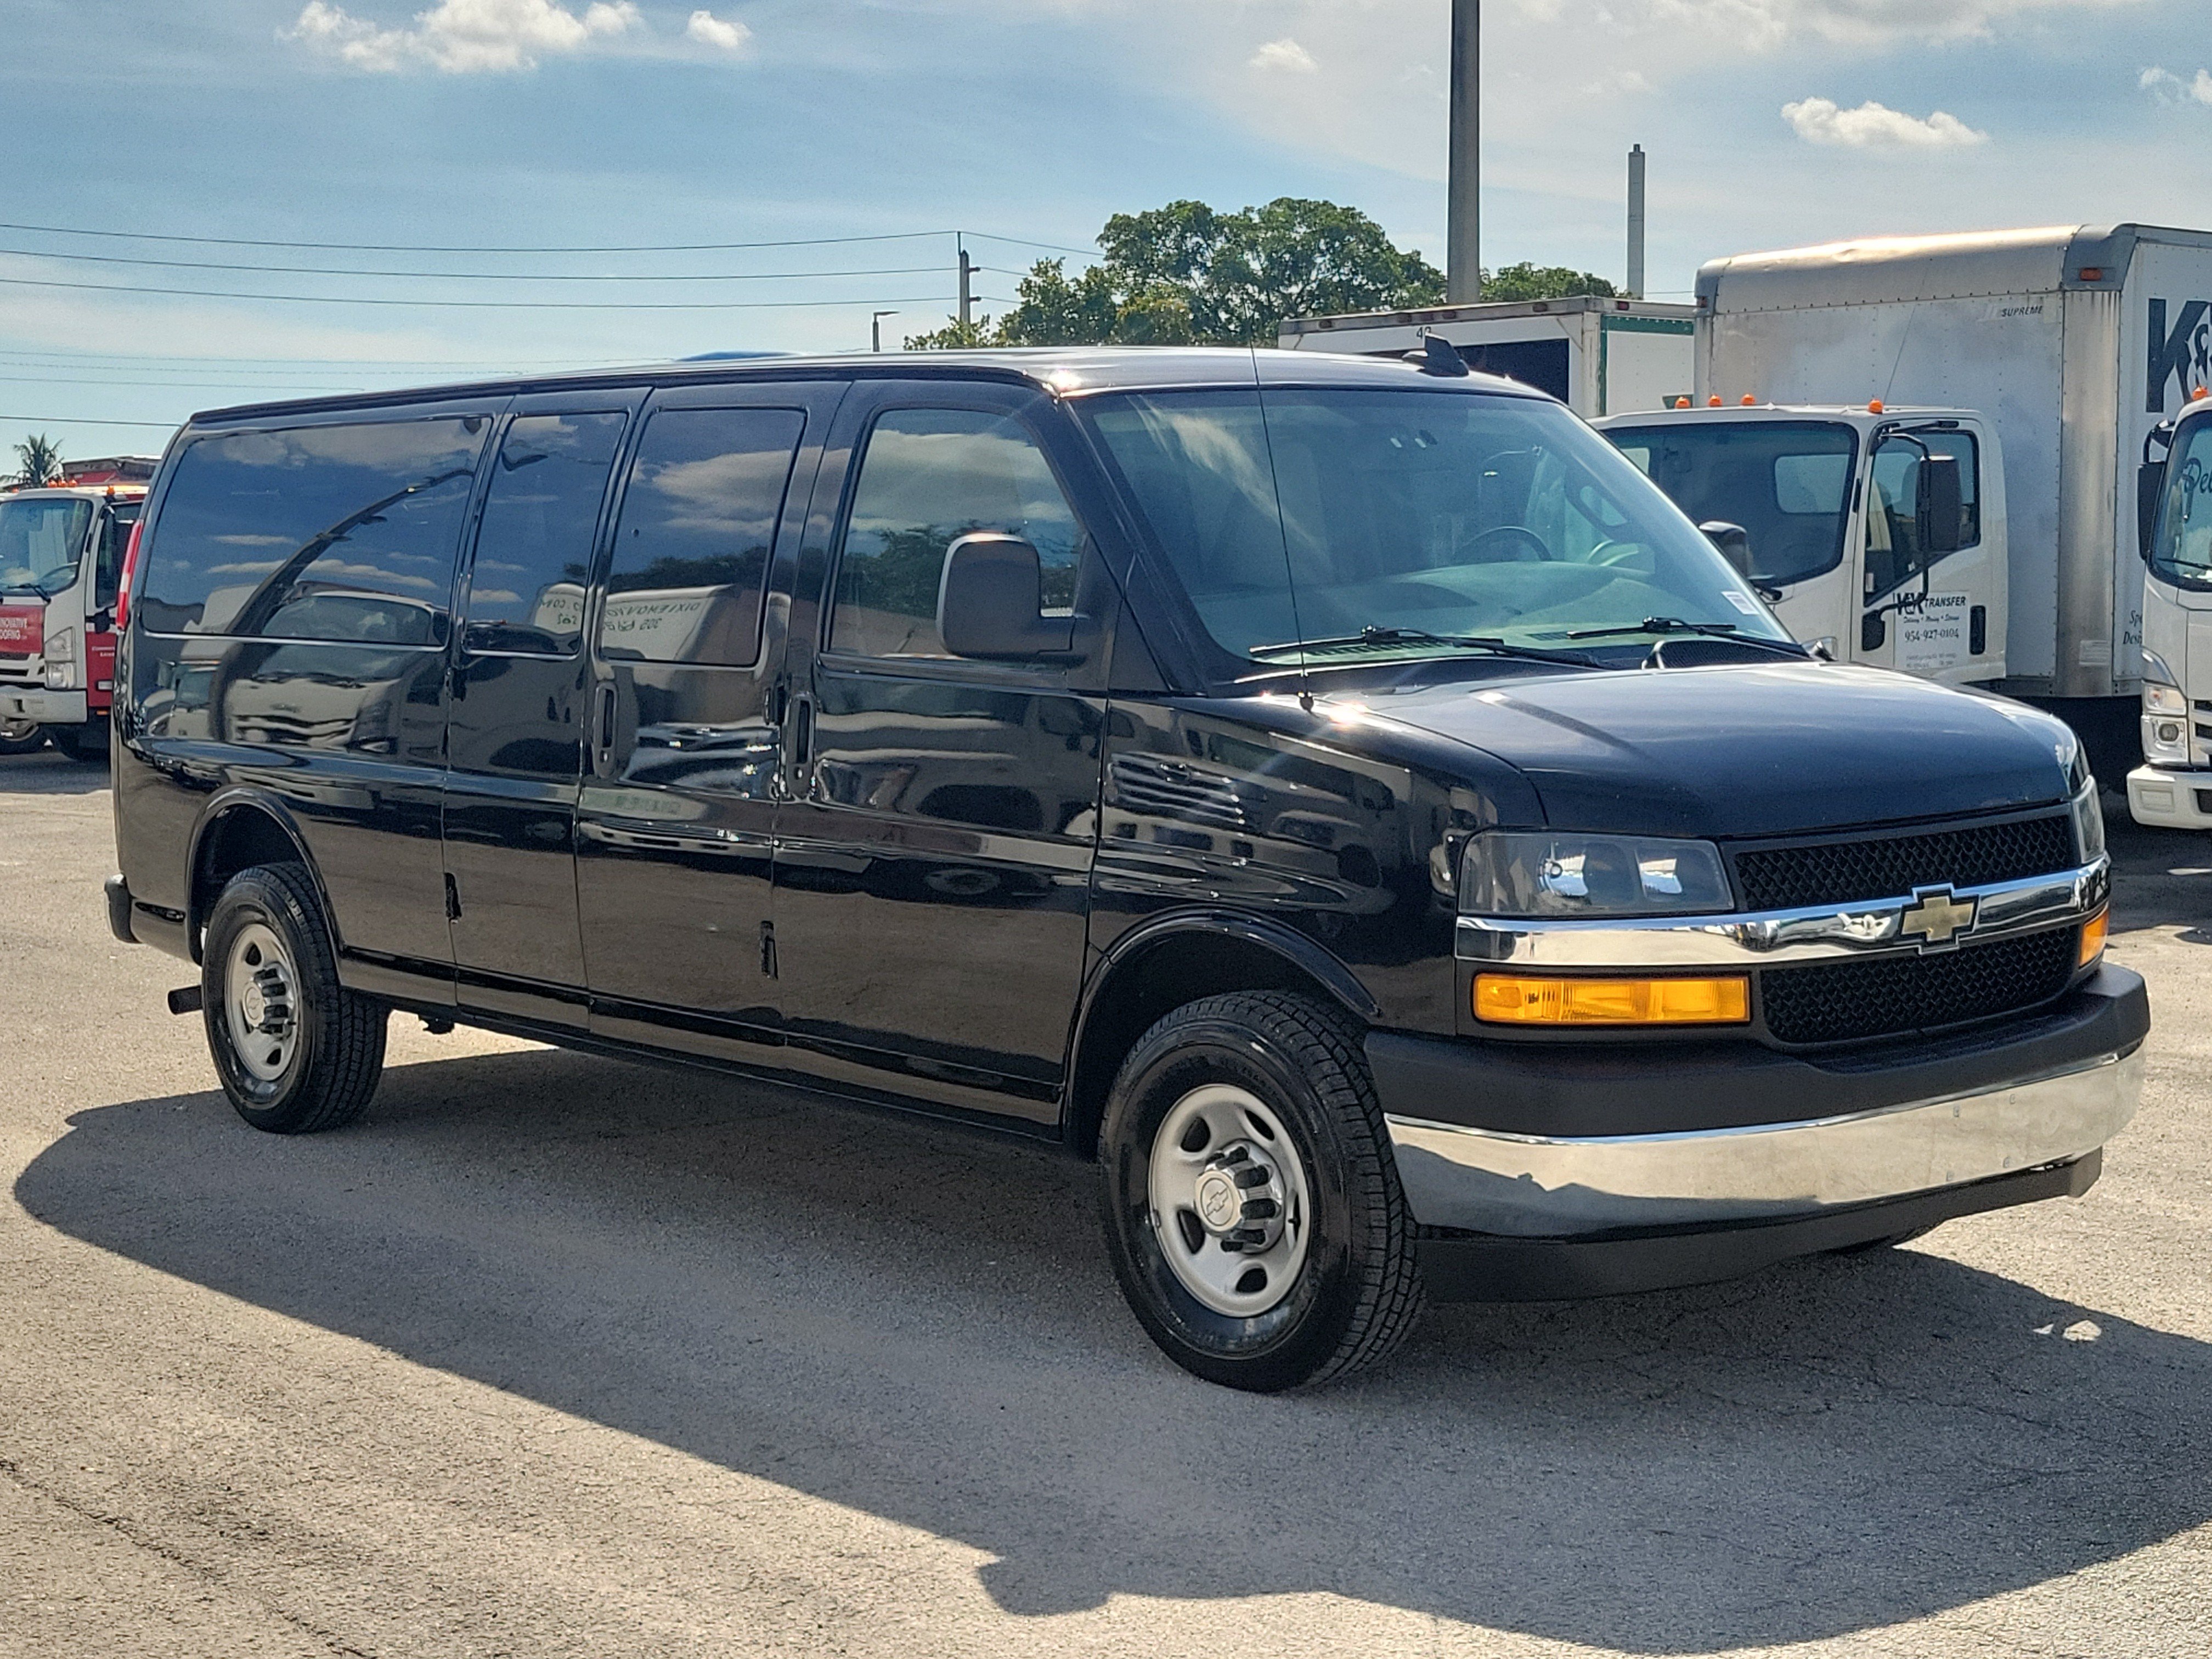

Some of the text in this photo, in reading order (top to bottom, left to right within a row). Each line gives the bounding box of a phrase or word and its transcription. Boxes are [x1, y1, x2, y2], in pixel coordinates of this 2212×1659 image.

[2001, 305, 2042, 317] SUPREME
[2146, 298, 2212, 413] K&
[1925, 596, 1966, 608] TRANSFER
[1904, 628, 1960, 642] 954-927-0104
